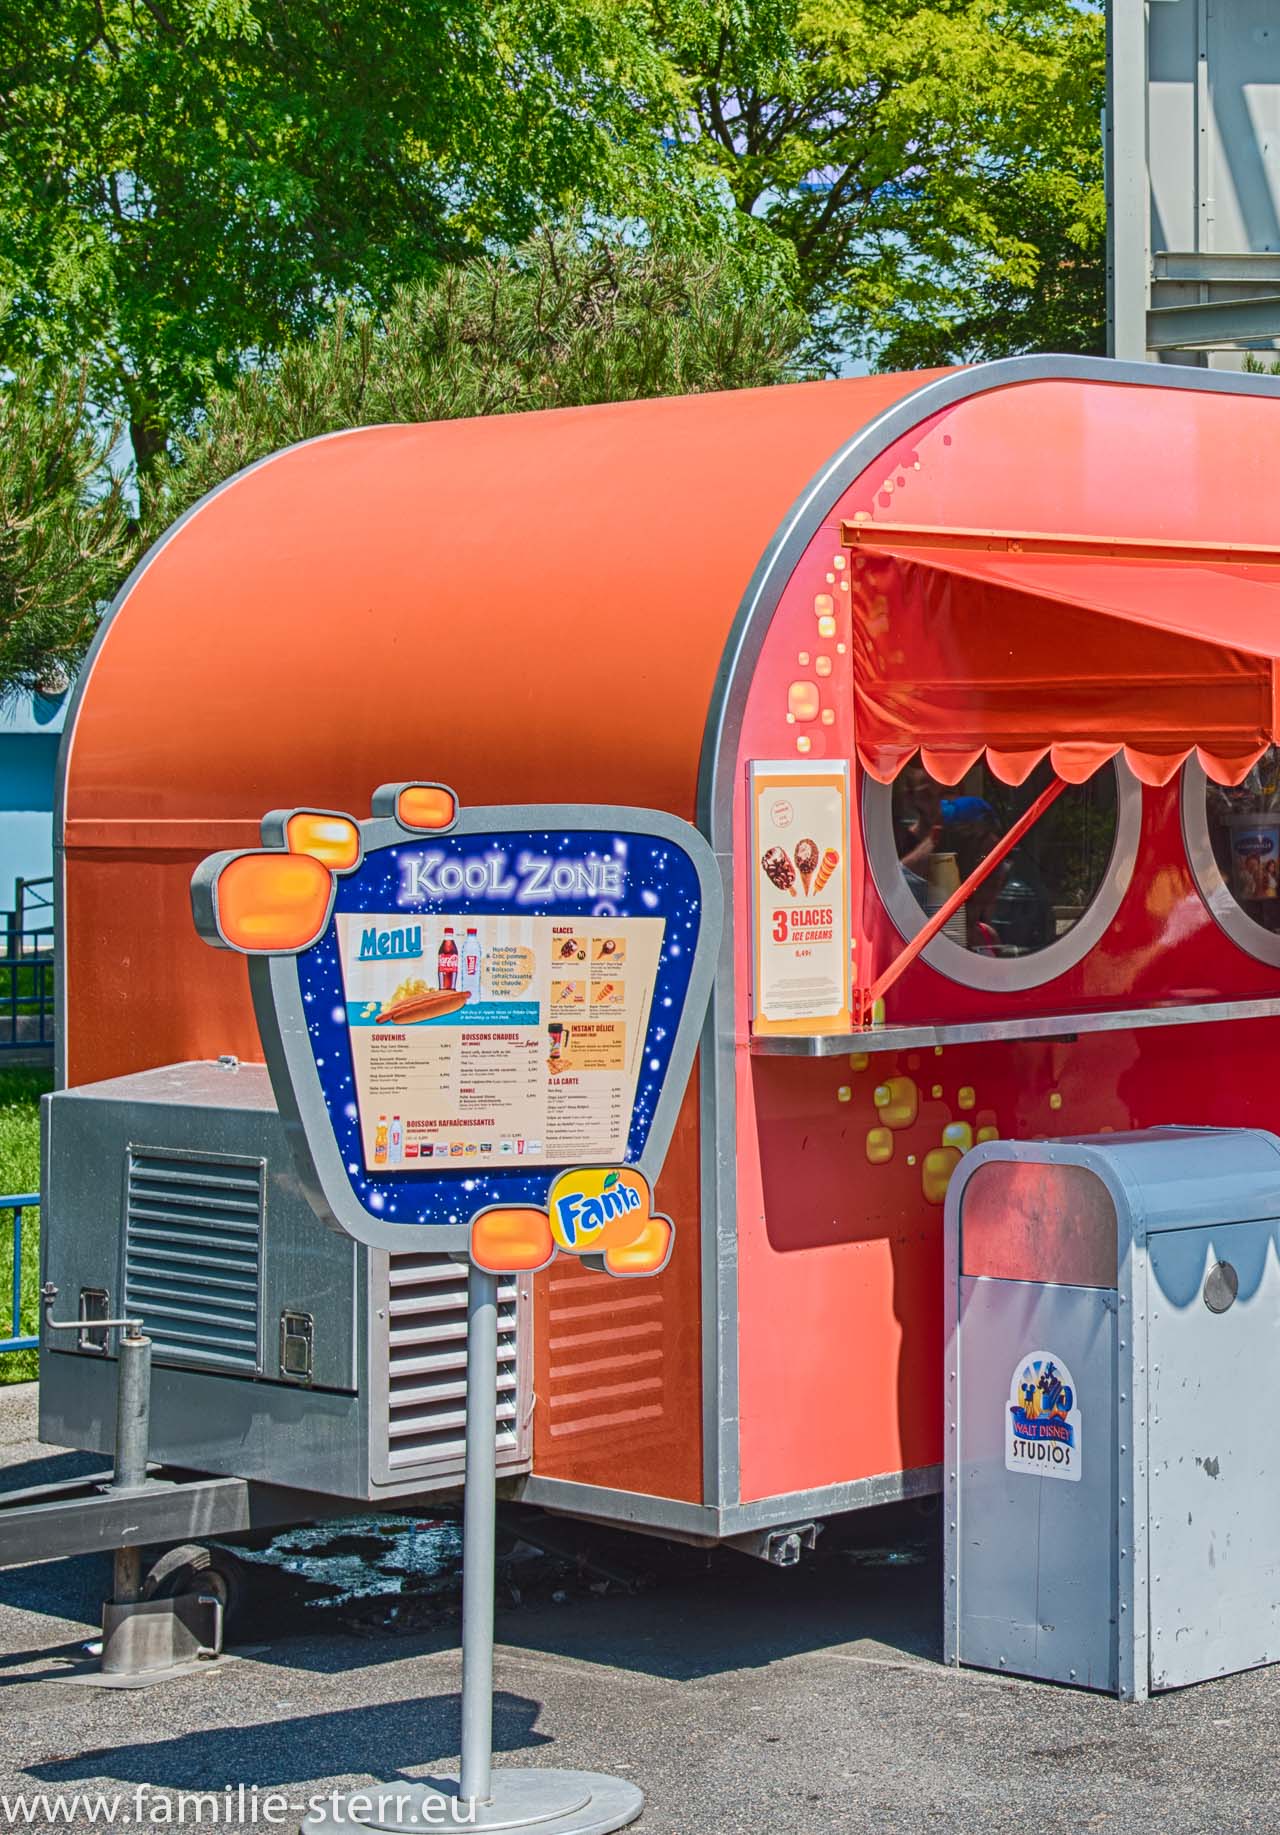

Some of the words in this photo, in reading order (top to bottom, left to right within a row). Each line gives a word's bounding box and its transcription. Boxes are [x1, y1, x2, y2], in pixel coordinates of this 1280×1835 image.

[406, 858, 513, 898] KOOL
[522, 861, 623, 897] ZONE
[772, 910, 788, 943] 3
[791, 909, 833, 927] GLACES
[792, 931, 804, 941] ICE
[805, 930, 833, 941] CREAMS
[360, 925, 422, 957] Menu
[596, 1024, 615, 1032] DÉLICE
[562, 1077, 579, 1085] CARTE
[556, 1182, 641, 1245] Fanta
[1014, 1422, 1037, 1437] WALT
[1039, 1425, 1070, 1440] DISNEY
[1013, 1440, 1070, 1465] STUDIOS
